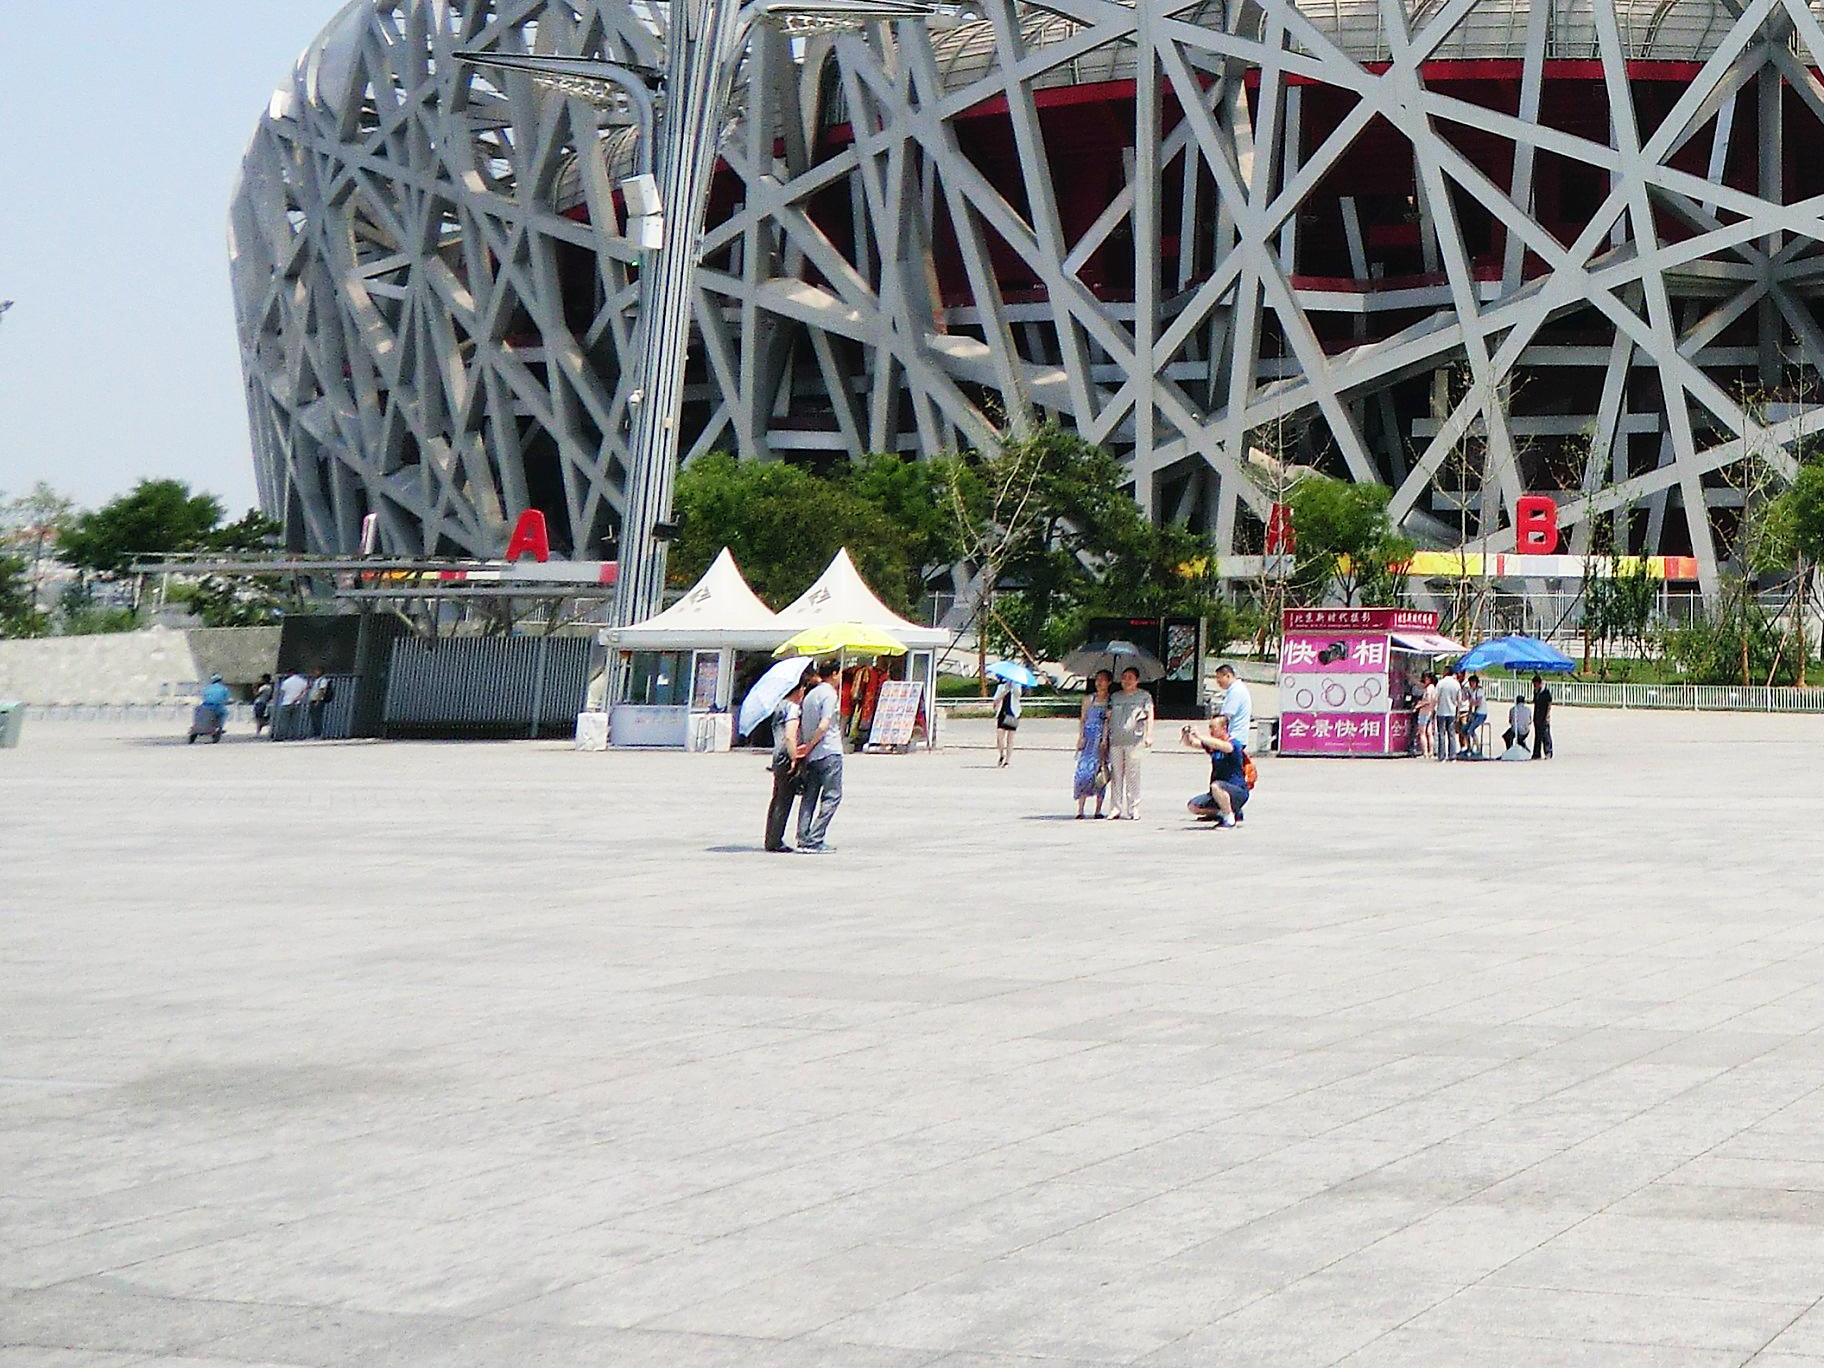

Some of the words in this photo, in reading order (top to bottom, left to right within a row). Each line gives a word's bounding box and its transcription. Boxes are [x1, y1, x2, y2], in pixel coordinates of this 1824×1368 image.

[505, 508, 549, 563] A
[1516, 495, 1559, 554] B
[1284, 639, 1317, 666] 快
[1352, 639, 1384, 666] 相
[1286, 718, 1381, 738] 全景快相
